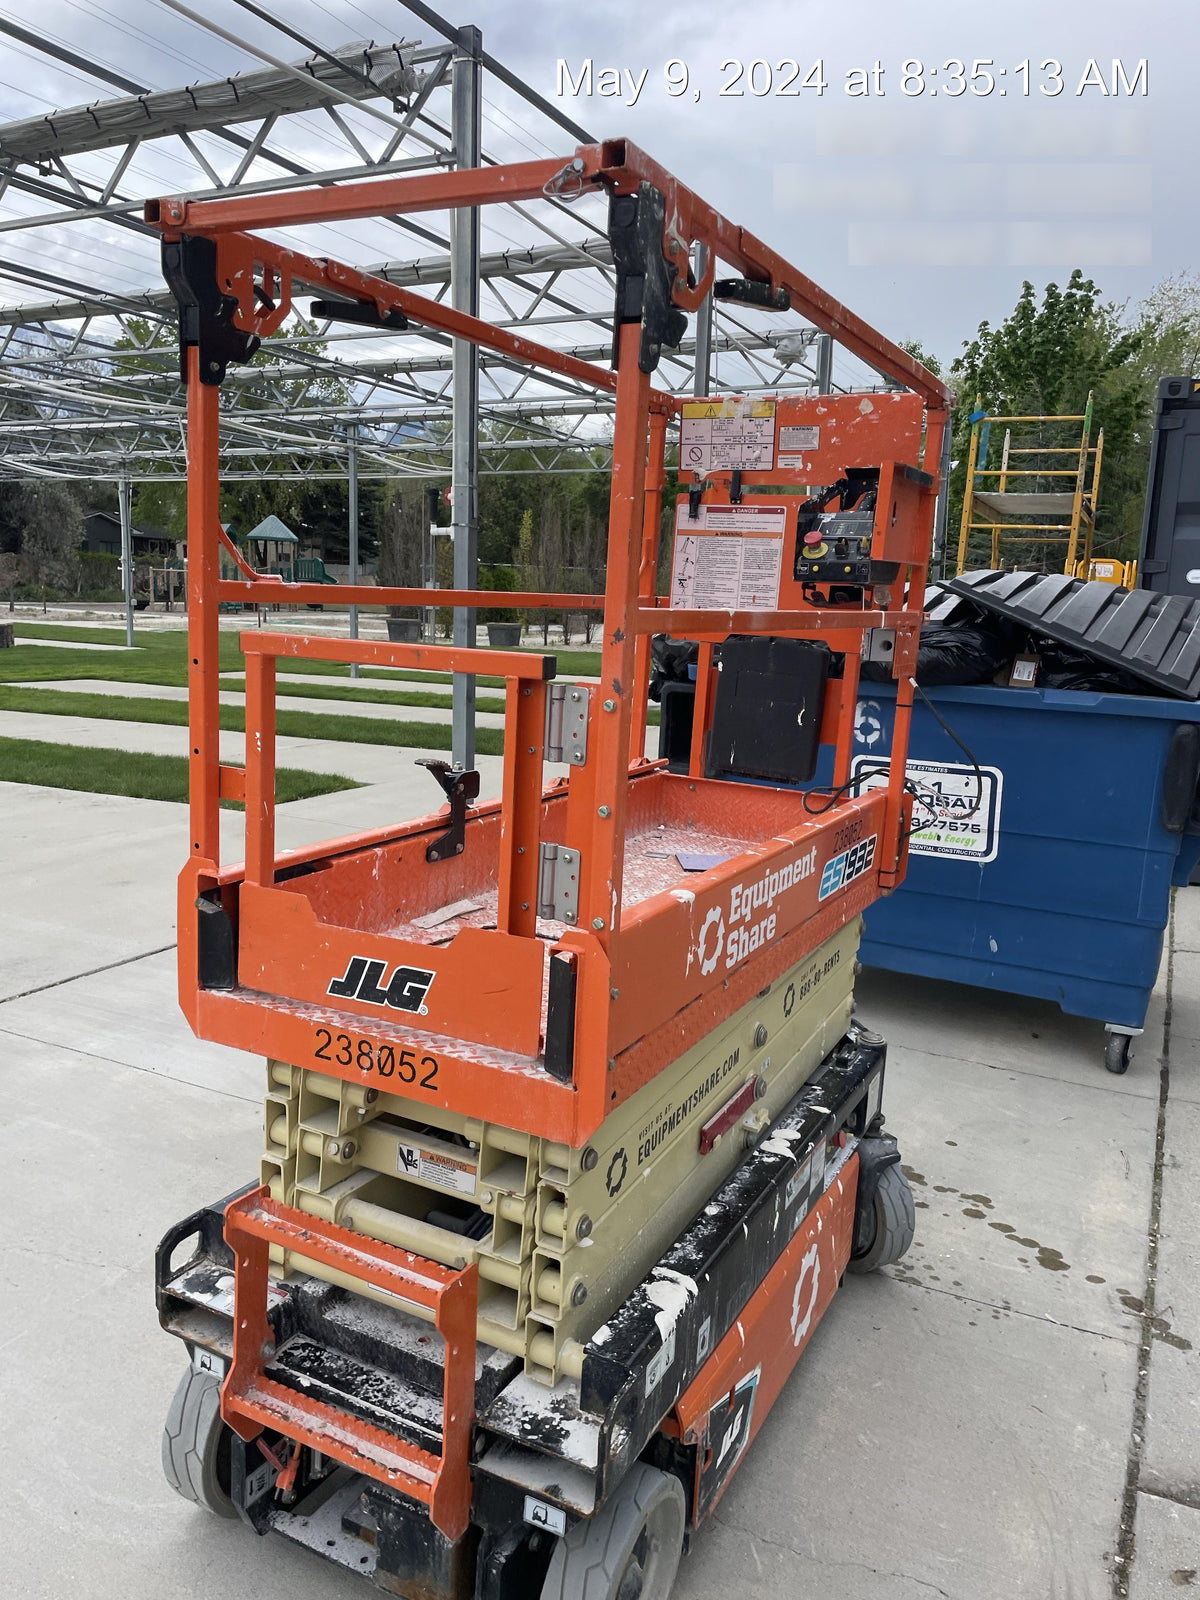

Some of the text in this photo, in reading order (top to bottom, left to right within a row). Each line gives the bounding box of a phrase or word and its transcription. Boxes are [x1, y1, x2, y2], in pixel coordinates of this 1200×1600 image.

[917, 765, 949, 774] ESTIMATES
[937, 847, 982, 857] CONSTRUCTION
[944, 833, 977, 847] Energy
[728, 845, 817, 924] Equipment
[819, 834, 877, 901] ES1932
[725, 913, 777, 969] Share
[326, 955, 436, 1014] JLG
[637, 1047, 740, 1166] EQUIPMENTSHARE.COM
[639, 1121, 654, 1140] VISIT
[655, 1111, 663, 1123] US
[433, 1154, 467, 1172] WARNING
